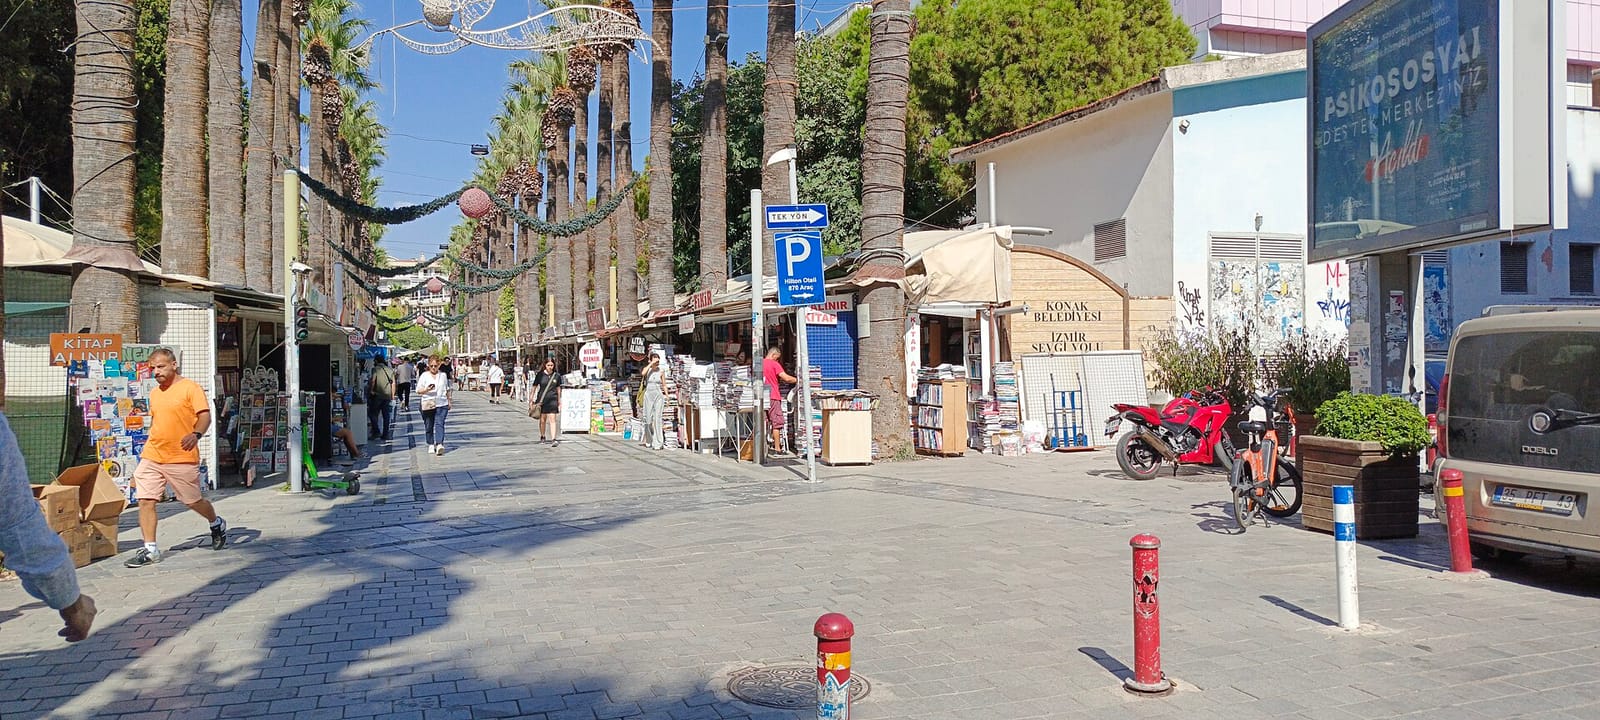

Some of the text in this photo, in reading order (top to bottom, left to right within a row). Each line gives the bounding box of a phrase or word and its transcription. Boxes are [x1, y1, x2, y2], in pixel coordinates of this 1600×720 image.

[1323, 113, 1377, 146] DESTEK
[771, 213, 788, 221] TEK
[785, 236, 811, 277] P
[1046, 301, 1089, 312] KONAK
[1034, 310, 1102, 323] BELEDİYESİ
[64, 336, 113, 349] KİTAP
[1051, 331, 1087, 343] İZMİR
[1031, 342, 1067, 353] SEVGİ
[1521, 445, 1559, 456] DOBLO
[1502, 488, 1518, 502] 35
[1556, 494, 1575, 510] 43
